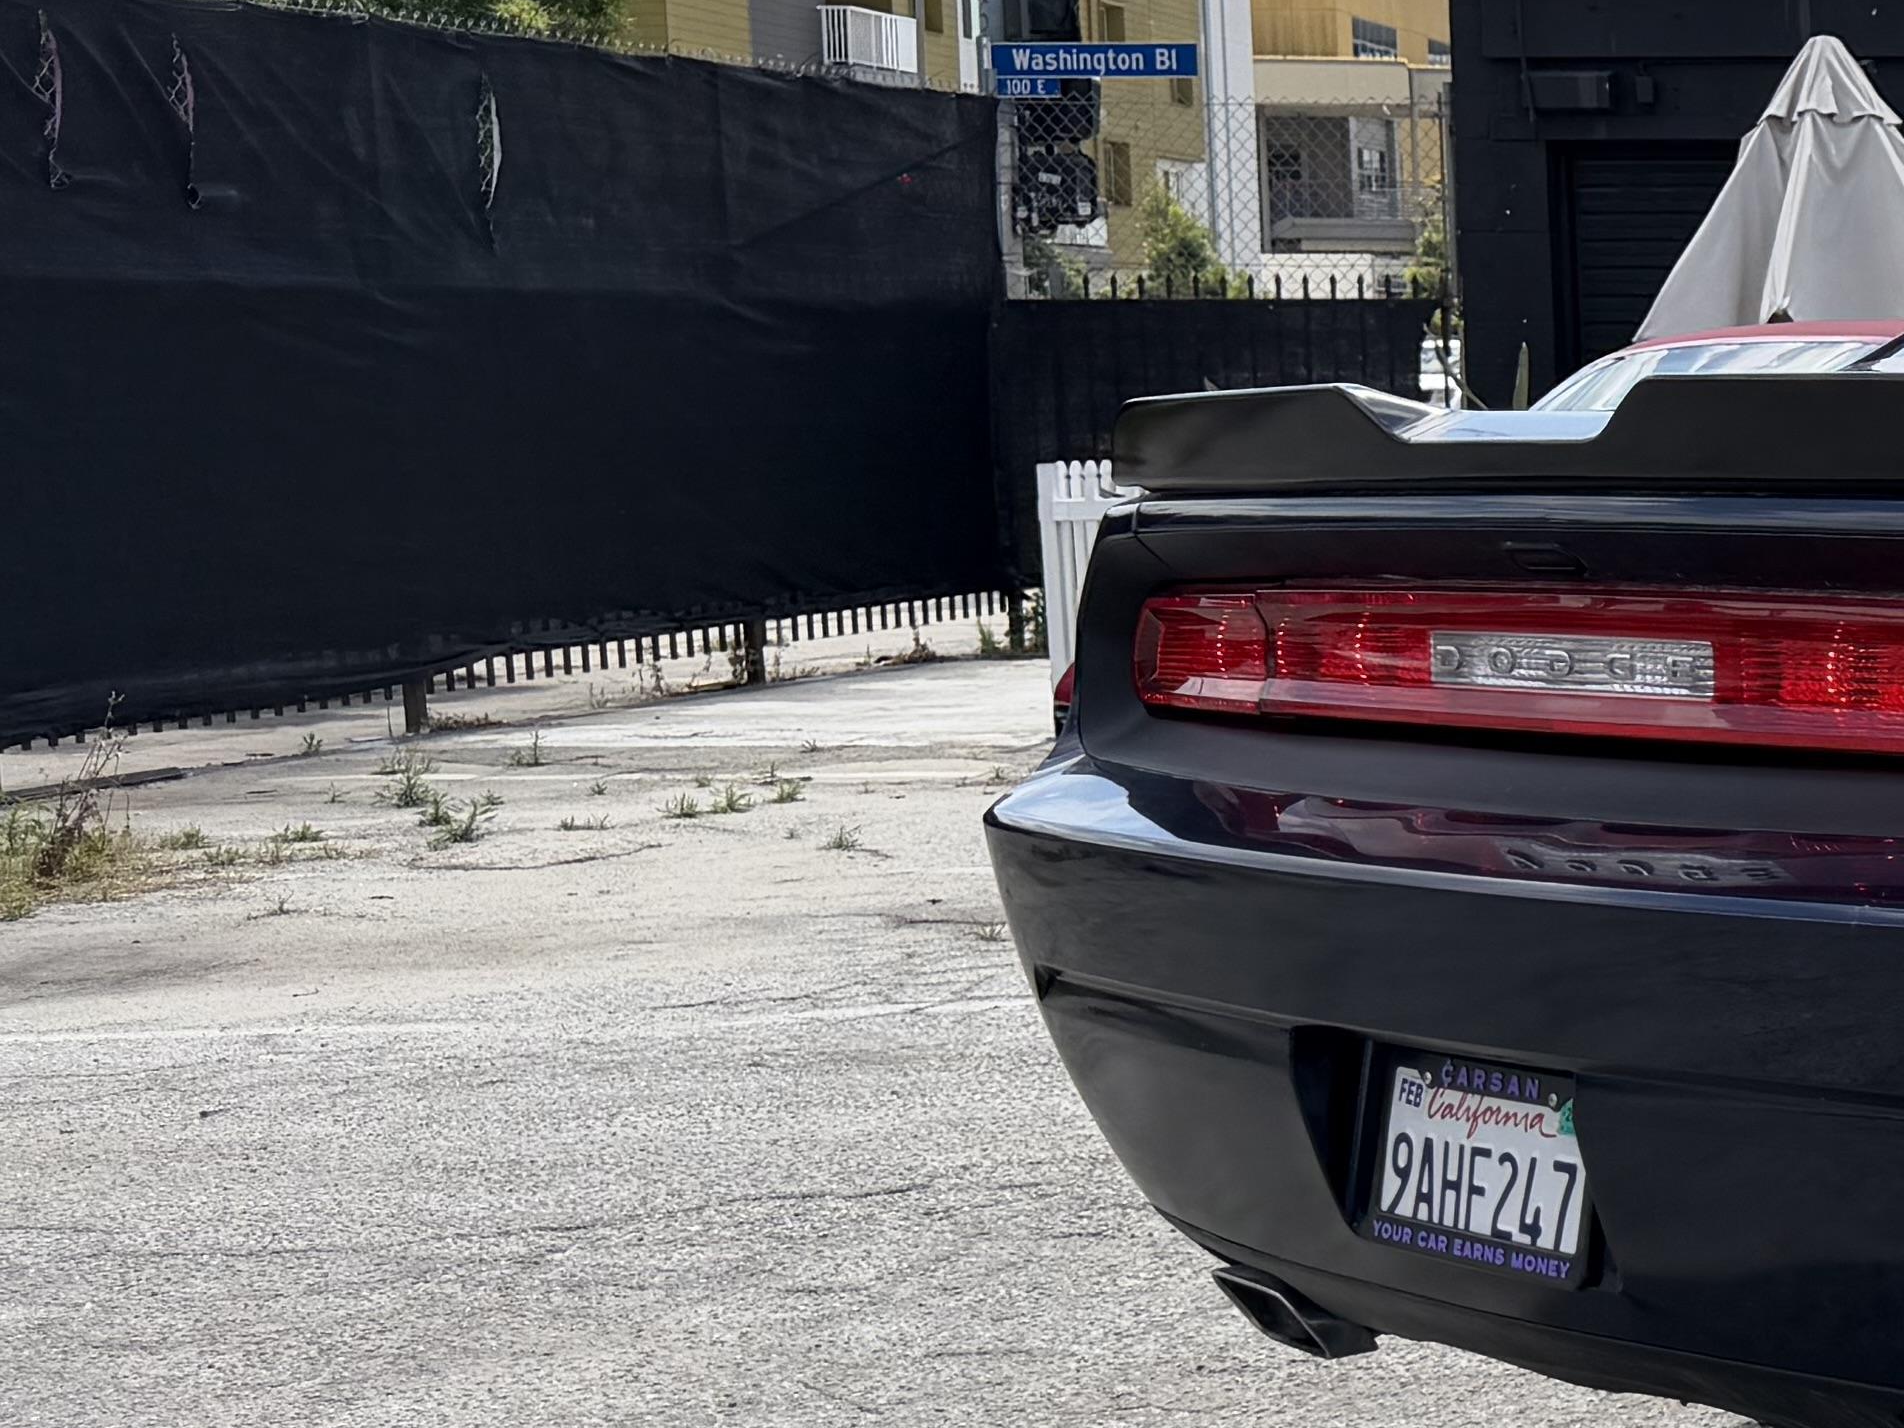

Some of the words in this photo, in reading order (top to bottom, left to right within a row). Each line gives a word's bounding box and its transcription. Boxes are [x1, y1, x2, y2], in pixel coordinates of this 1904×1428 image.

[1012, 48, 1144, 76] Washington
[1155, 48, 1177, 70] Bl
[1006, 79, 1032, 95] 100
[1037, 79, 1046, 95] E
[1434, 644, 1695, 682] DODGE
[1399, 1077, 1424, 1108] FEB
[1442, 1059, 1540, 1100] CARSAN
[1428, 1086, 1557, 1140] California
[1388, 1132, 1577, 1251] 9AHF247
[1373, 1220, 1412, 1244] YOUR
[1417, 1231, 1447, 1253] CAR
[1453, 1239, 1505, 1266] EARNS
[1510, 1252, 1571, 1279] MONEY
